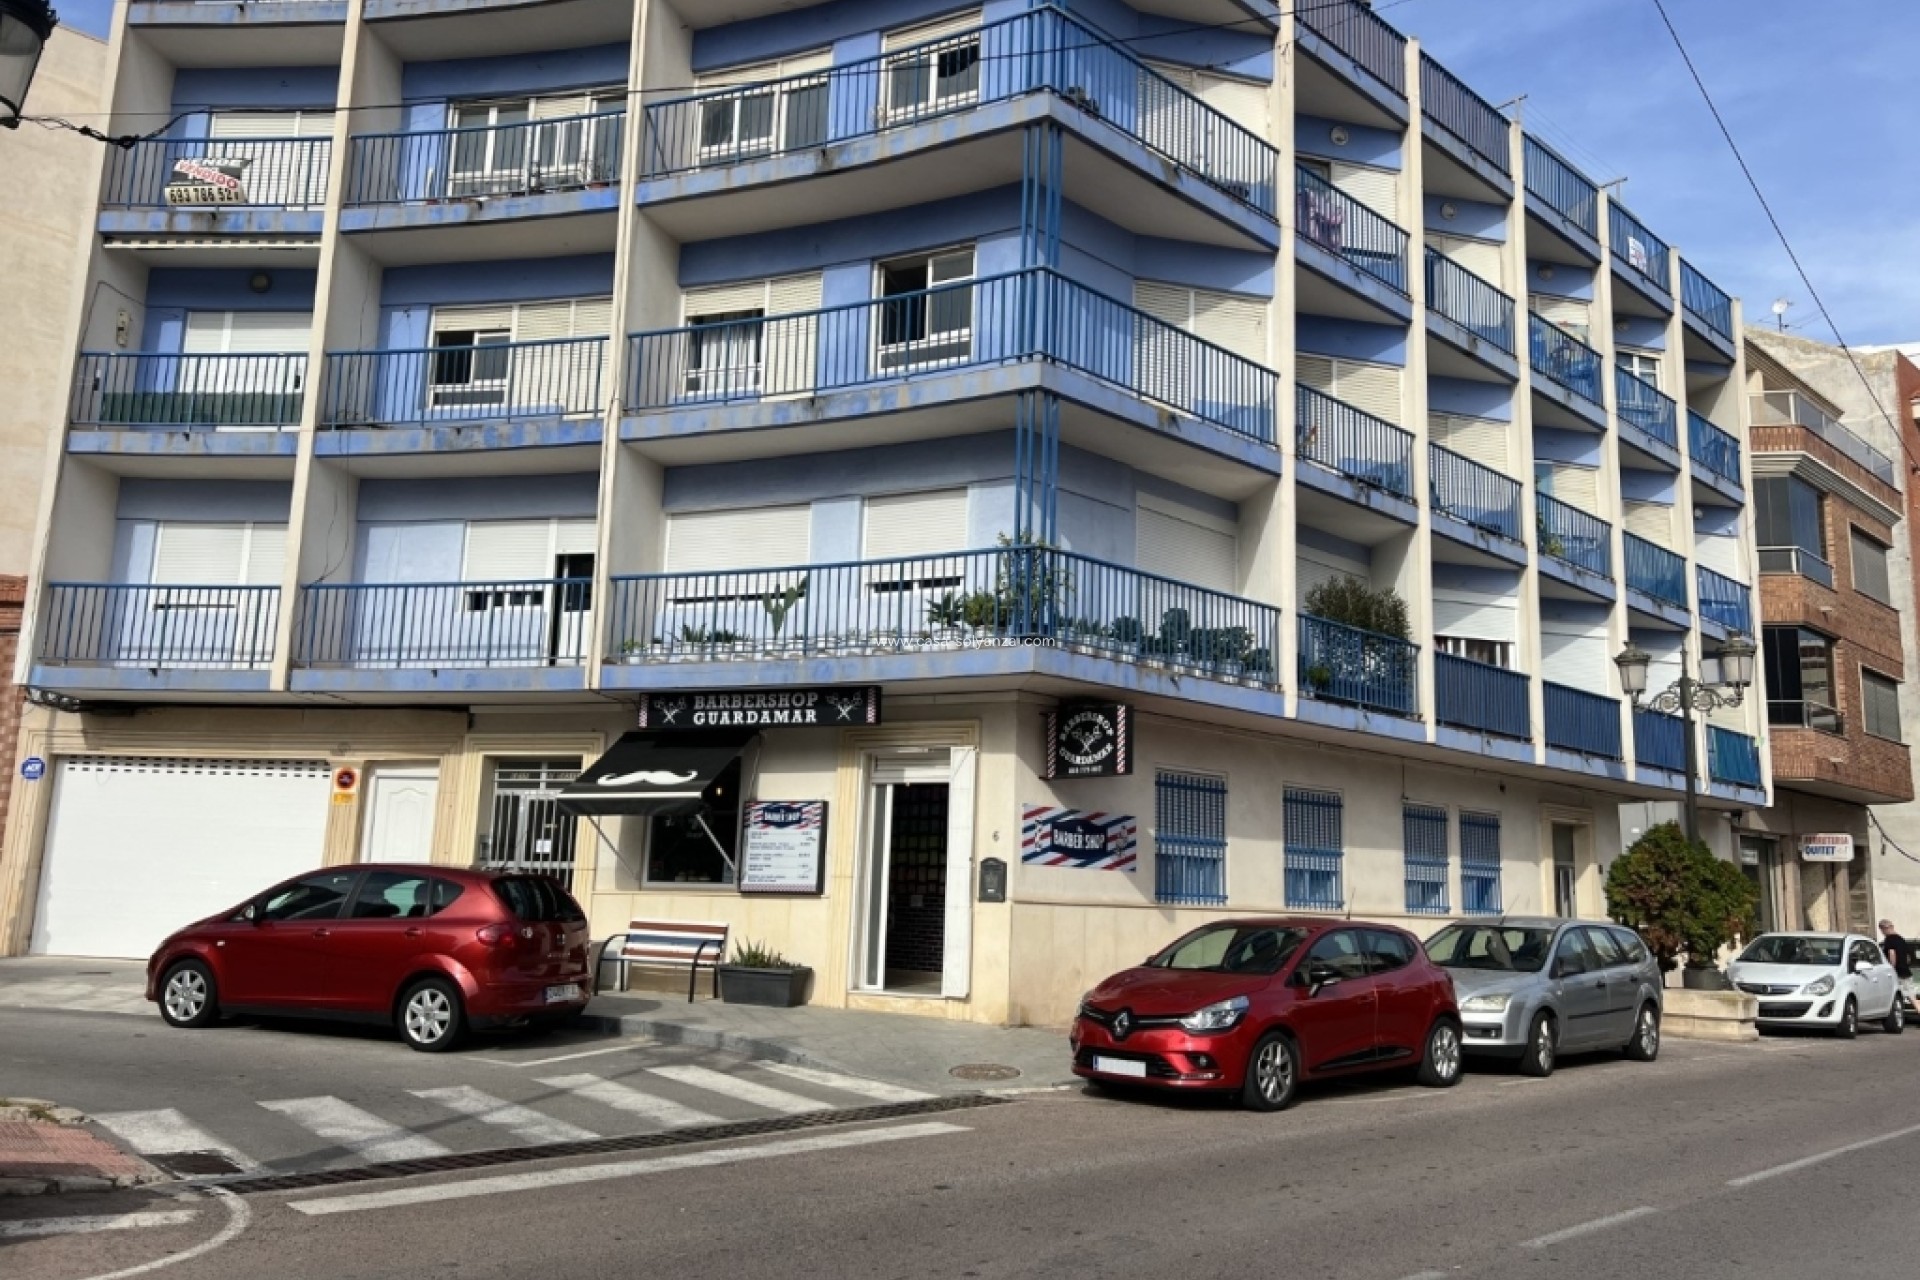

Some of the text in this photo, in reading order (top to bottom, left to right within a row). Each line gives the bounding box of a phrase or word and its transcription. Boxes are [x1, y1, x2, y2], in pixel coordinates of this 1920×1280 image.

[693, 692, 818, 710] BARBERSHOP
[693, 708, 817, 725] GUARDAMAR
[1060, 711, 1114, 741] BARBERSHOP
[1060, 743, 1114, 765] GUARDAMAR
[1053, 828, 1084, 849] BARBER
[1085, 833, 1105, 849] SHOP
